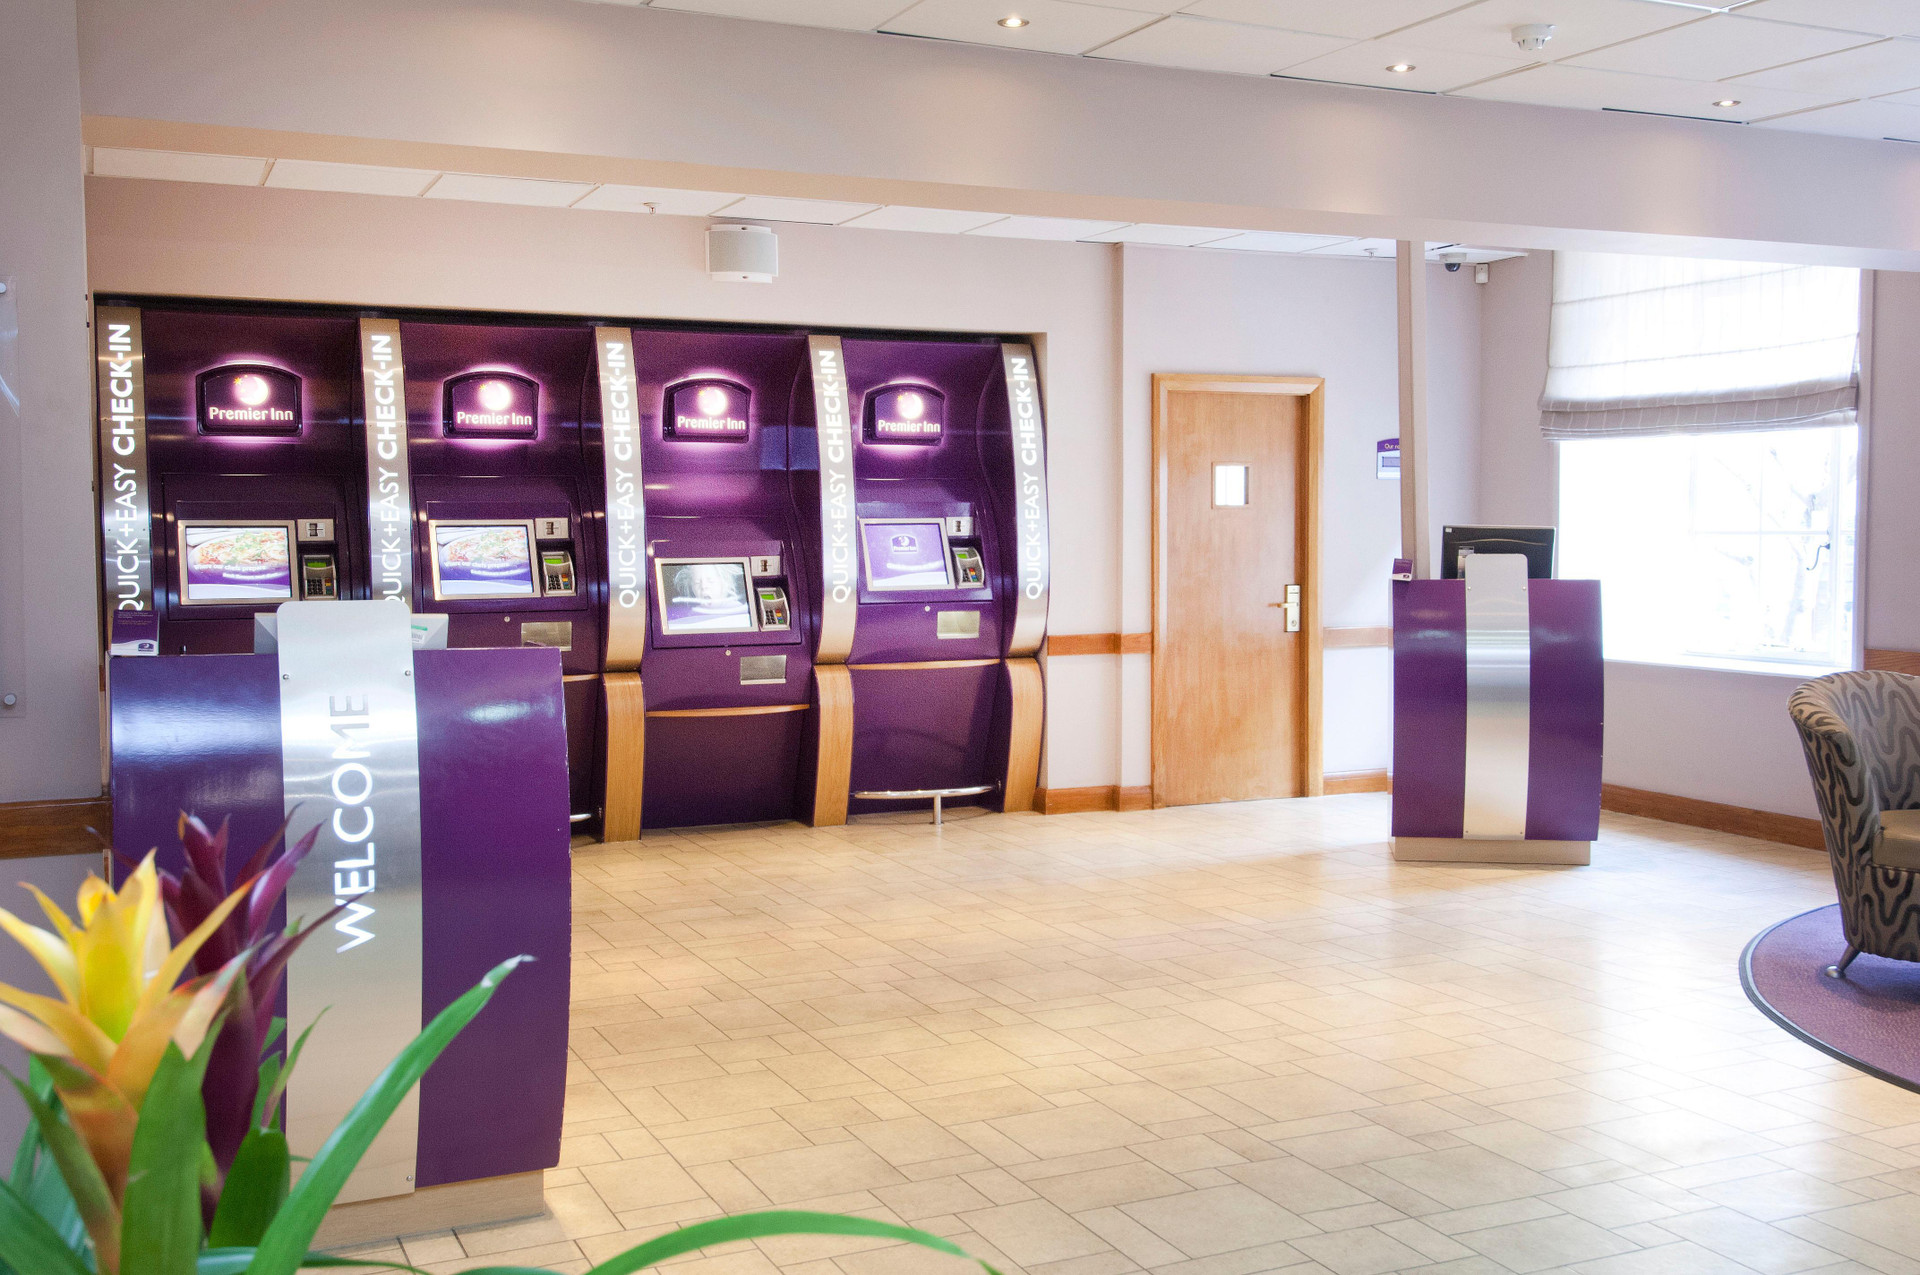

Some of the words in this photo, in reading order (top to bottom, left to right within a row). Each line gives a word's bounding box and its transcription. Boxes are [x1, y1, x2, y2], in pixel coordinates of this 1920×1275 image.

[108, 324, 135, 456] CHECK-IN
[209, 406, 268, 420] Premier
[270, 407, 294, 421] Inn
[371, 335, 397, 460] CHECK-IN
[457, 411, 510, 425] Premier
[511, 412, 532, 425] Inn
[606, 342, 633, 461] CHECK-IN
[677, 415, 725, 429] Premier
[727, 417, 746, 430] Inn
[819, 350, 845, 463] CHECK-IN
[878, 419, 922, 433] Premier
[923, 420, 940, 433] Inn
[1011, 357, 1037, 466] CHECK-IN
[378, 467, 405, 603] UICK+EASY
[329, 694, 376, 954] WELCOME
